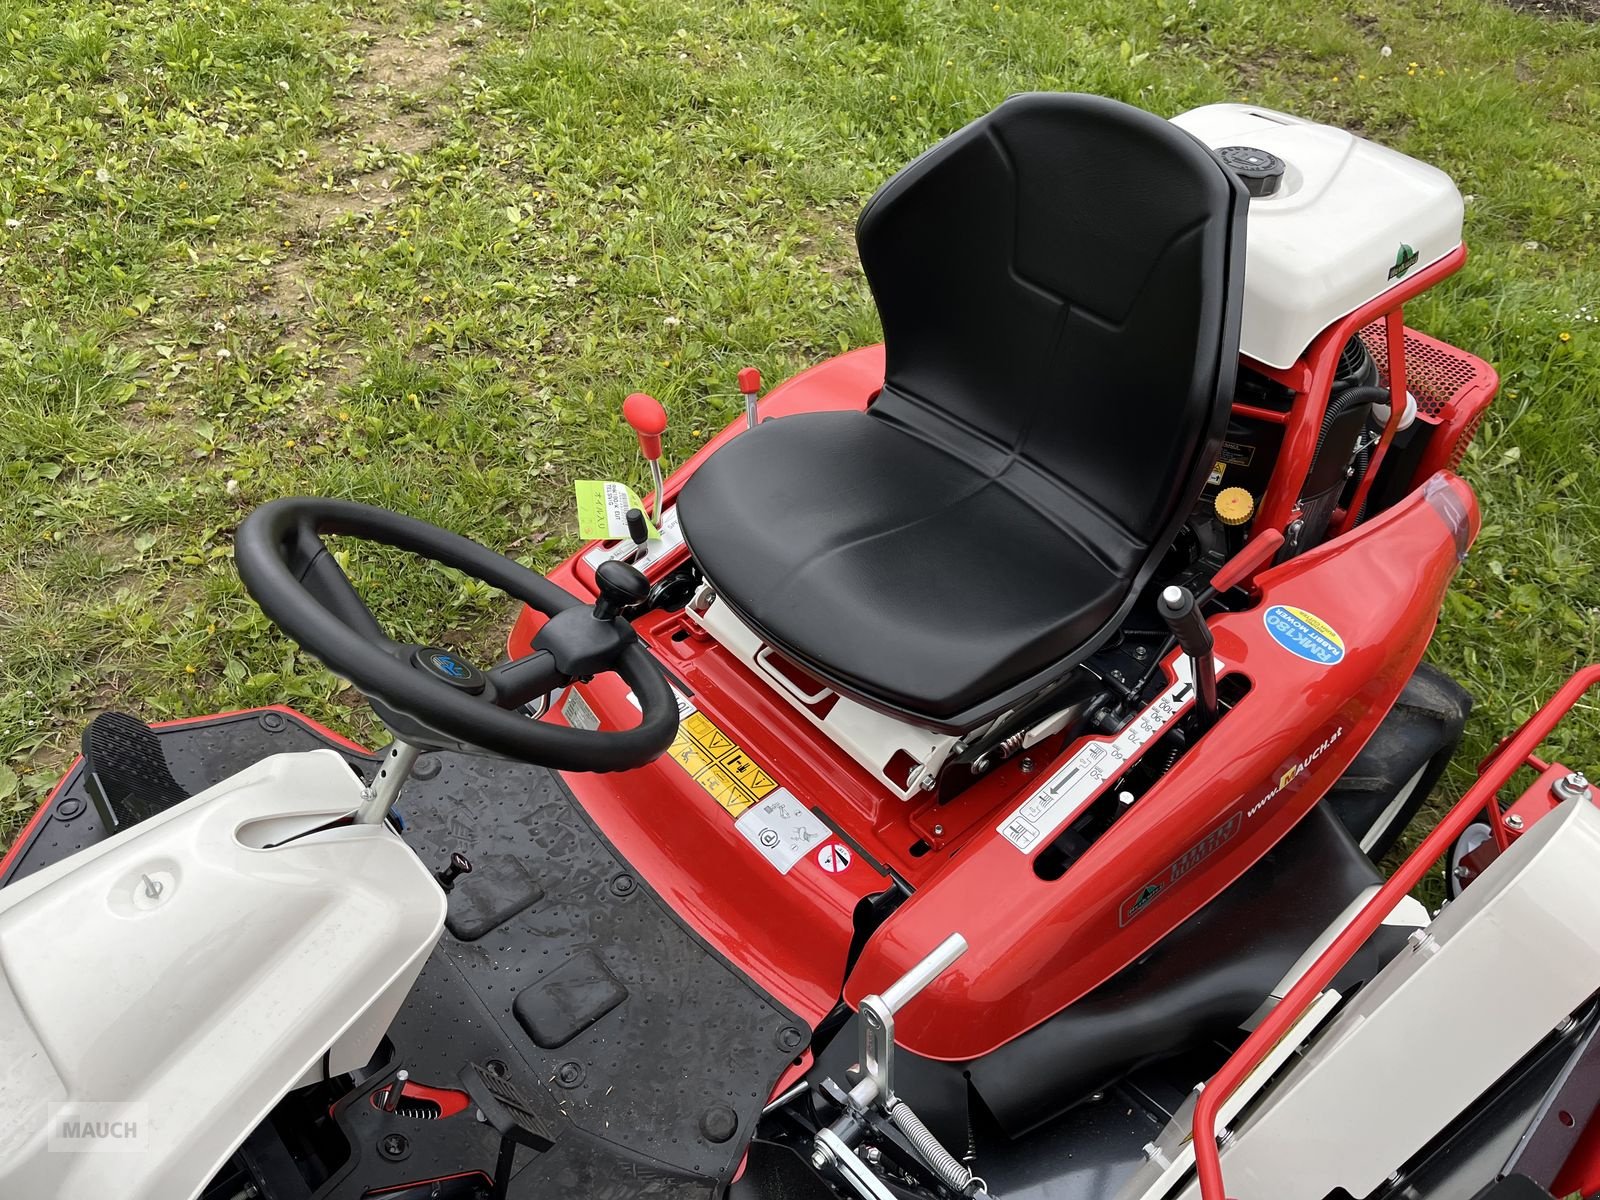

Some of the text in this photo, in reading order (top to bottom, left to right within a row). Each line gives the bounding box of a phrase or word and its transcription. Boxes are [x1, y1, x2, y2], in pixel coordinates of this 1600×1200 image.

[1275, 608, 1310, 633] MOWER
[1267, 615, 1332, 662] RMK180
[1307, 632, 1340, 656] RABBIT
[1158, 702, 1172, 714] 100
[1150, 712, 1162, 722] 90
[1140, 722, 1153, 732] 80
[1128, 734, 1140, 745] 70
[1111, 750, 1123, 760] 60
[1089, 770, 1103, 780] 50
[1247, 726, 1343, 818] www.MAUCH.at
